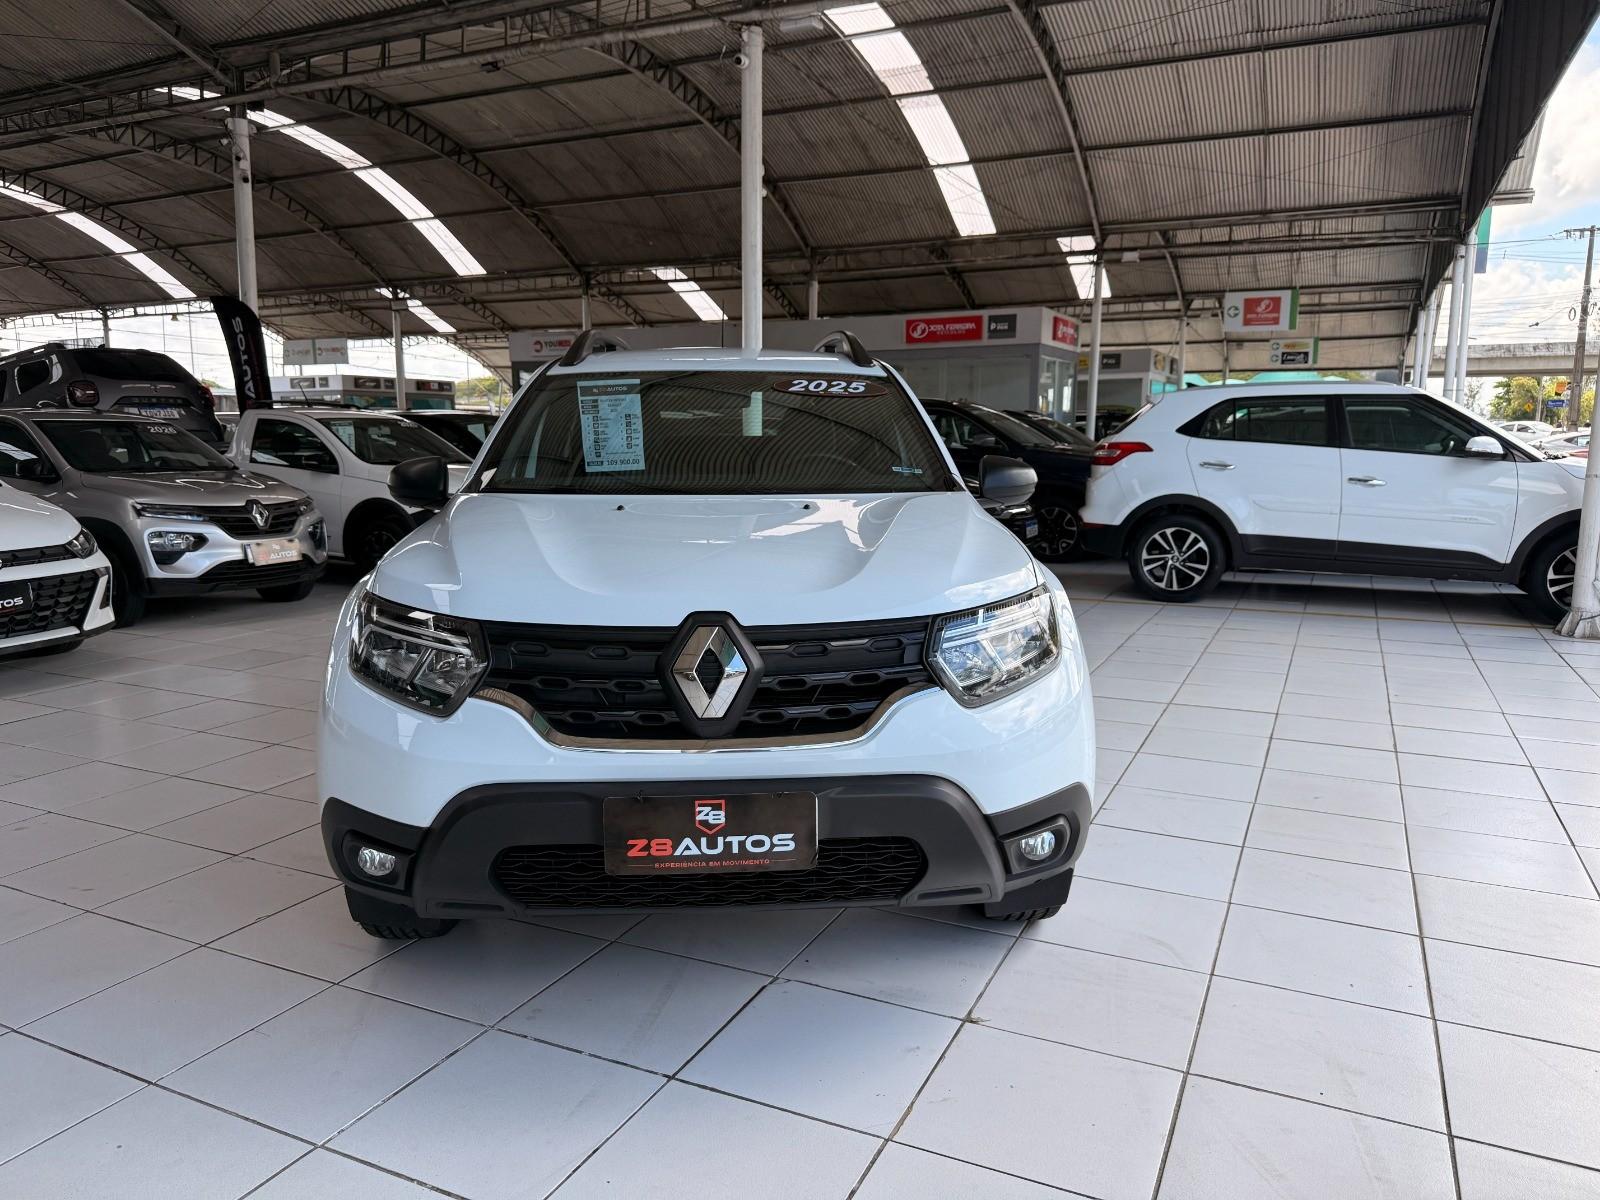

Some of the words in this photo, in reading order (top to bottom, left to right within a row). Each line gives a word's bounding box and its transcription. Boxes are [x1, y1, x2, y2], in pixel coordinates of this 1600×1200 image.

[788, 379, 867, 393] 2025
[147, 426, 177, 434] 2026
[695, 806, 726, 824] Z8
[626, 833, 796, 858] Z8AUTOS
[722, 859, 770, 867] MOVIMENTO
